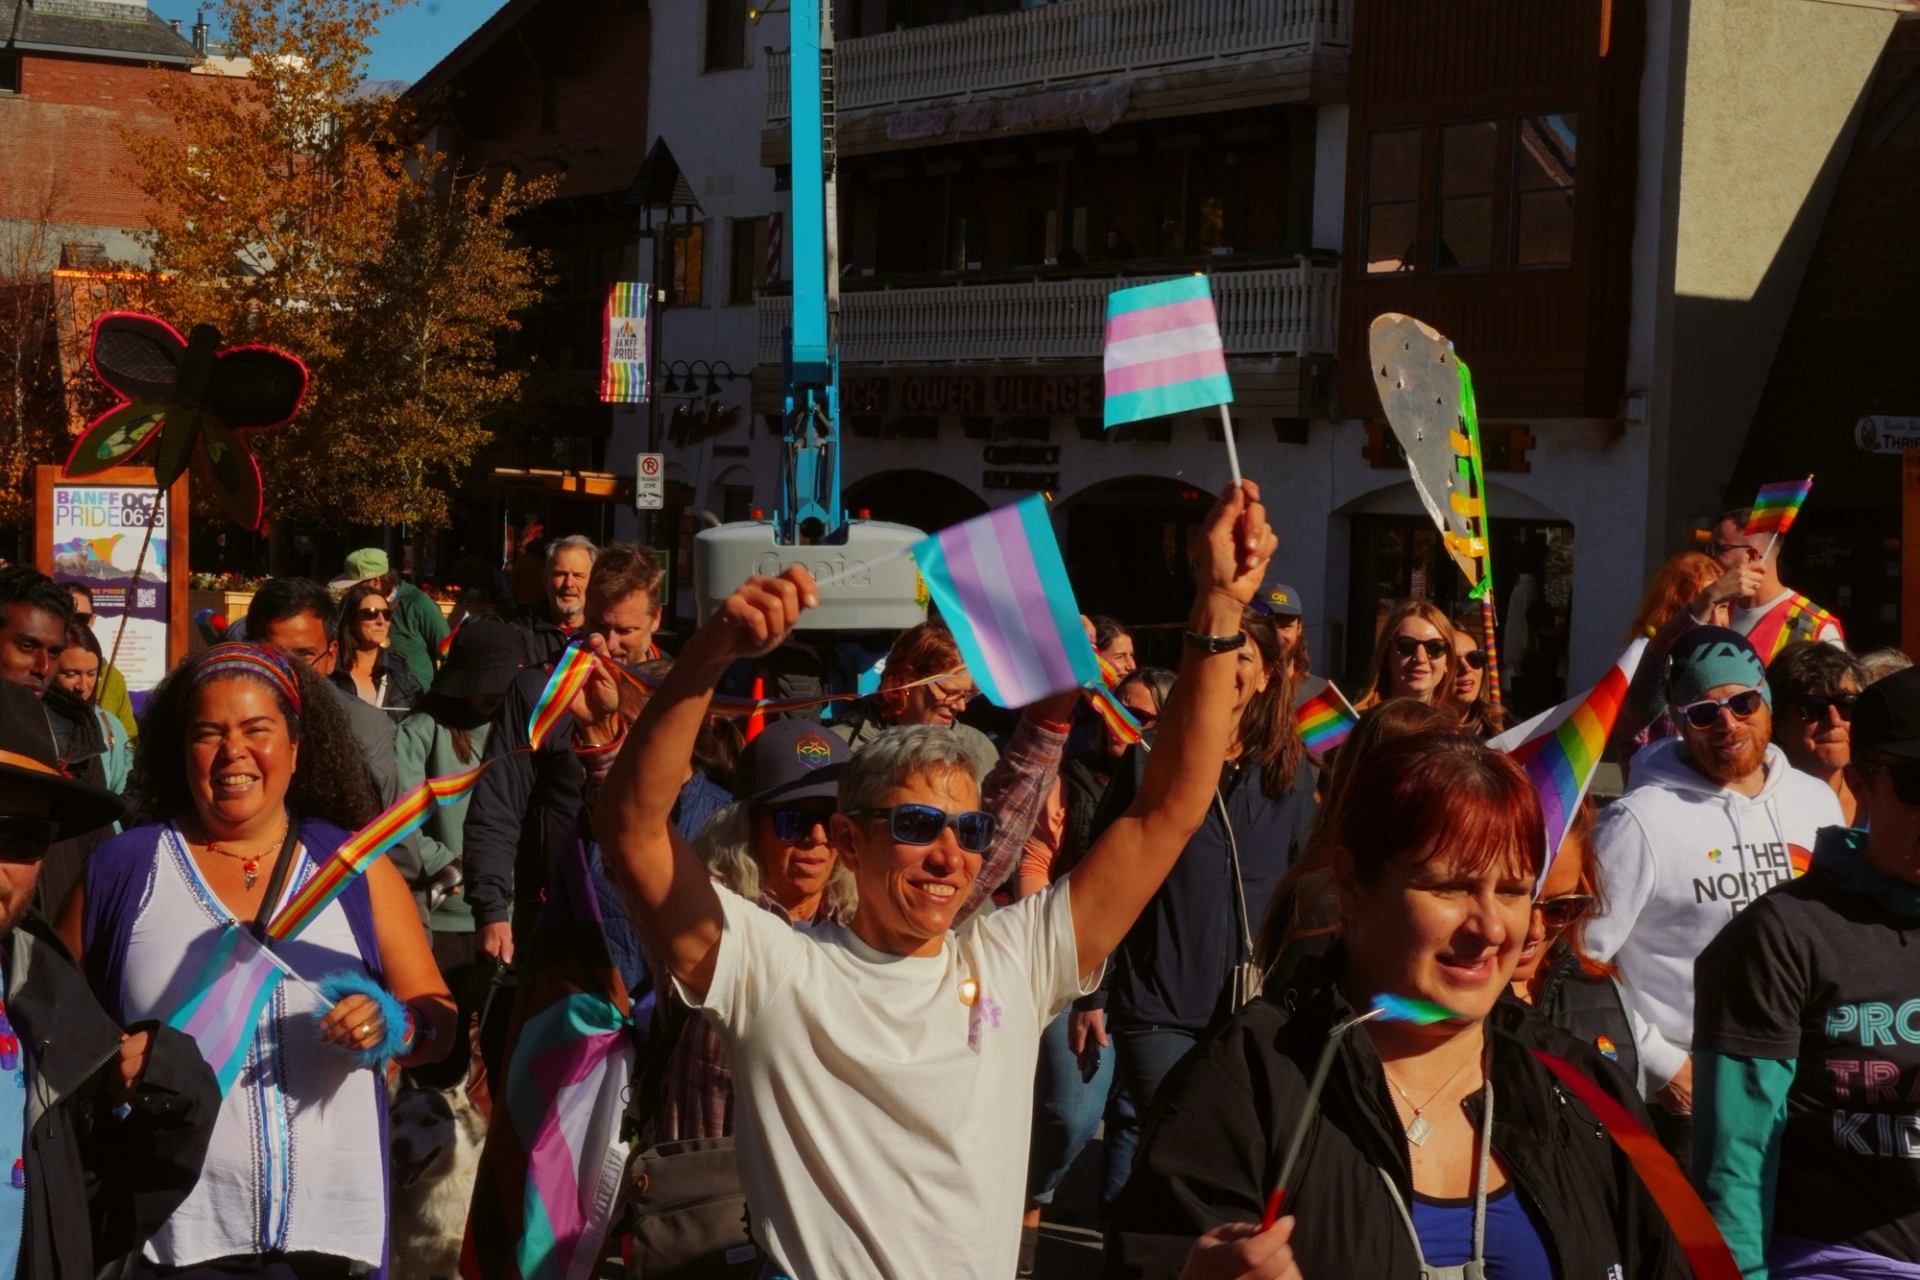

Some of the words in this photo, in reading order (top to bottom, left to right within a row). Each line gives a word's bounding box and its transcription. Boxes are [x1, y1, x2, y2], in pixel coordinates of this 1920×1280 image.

[614, 348, 638, 360] PRIDE
[896, 376, 978, 413] TOWER
[56, 491, 120, 505] BANFF
[56, 505, 120, 527] PRIDE
[1271, 592, 1288, 604] OR
[1731, 842, 1789, 869] THE
